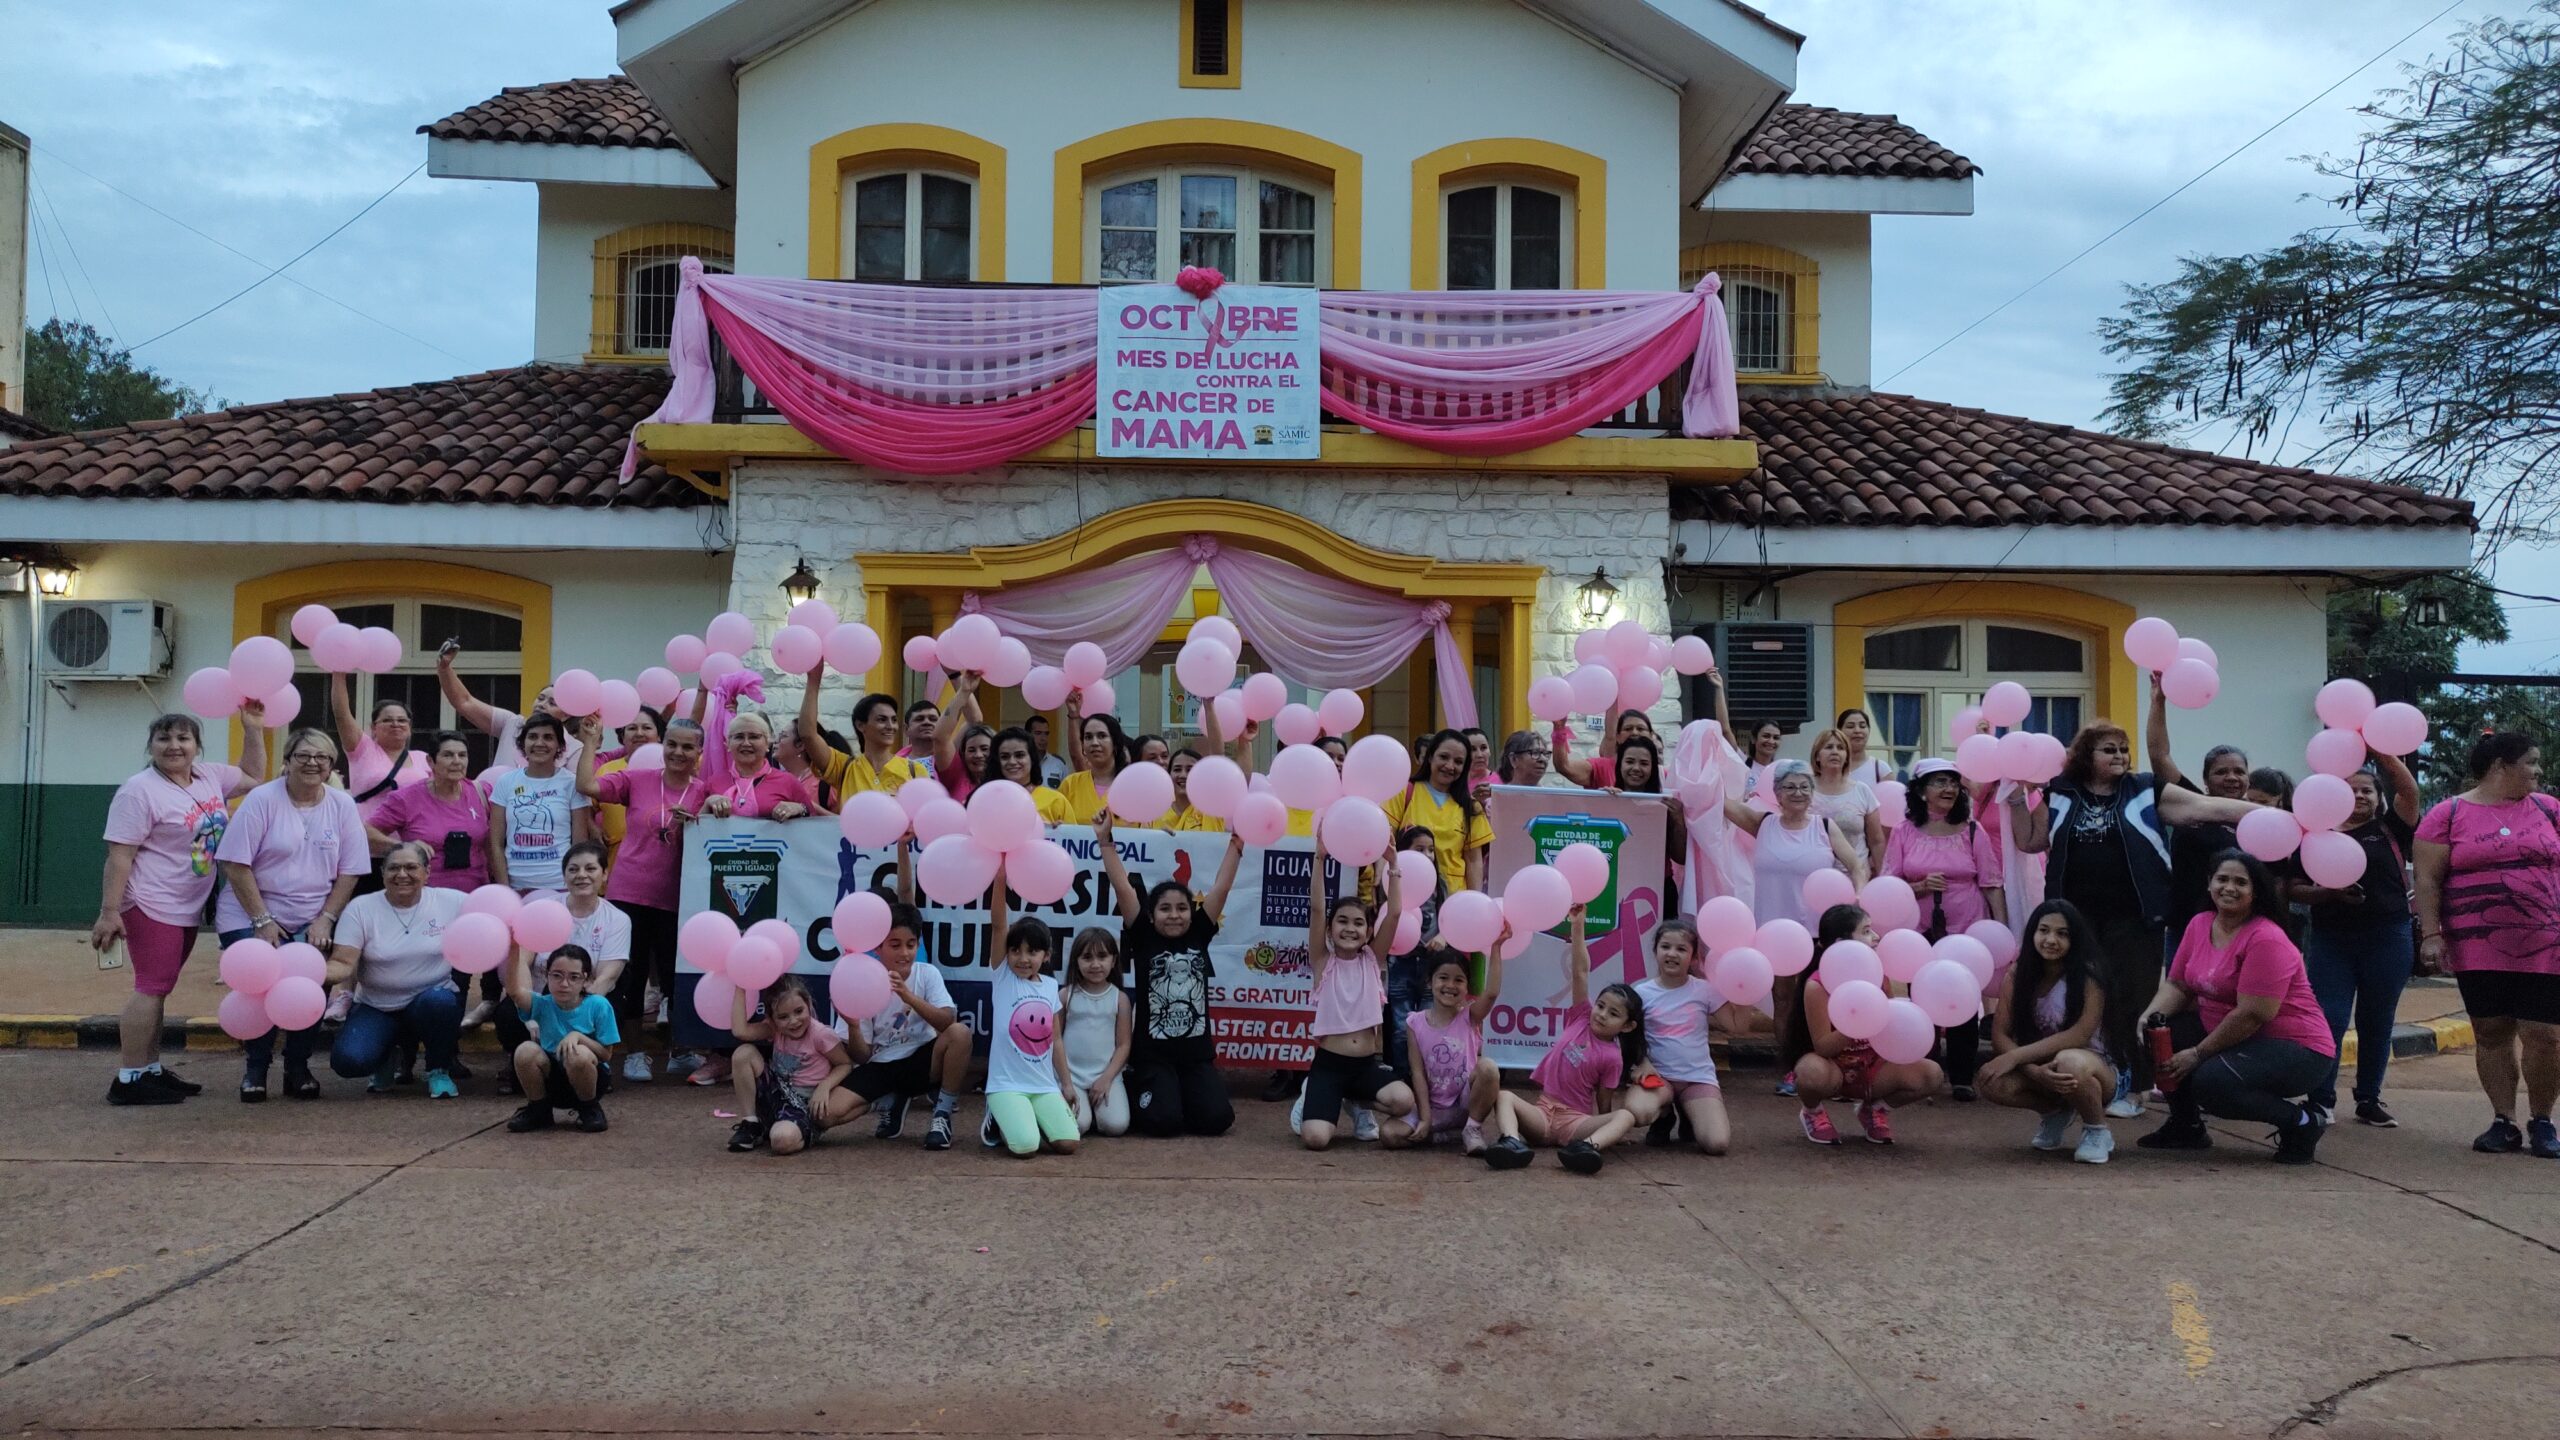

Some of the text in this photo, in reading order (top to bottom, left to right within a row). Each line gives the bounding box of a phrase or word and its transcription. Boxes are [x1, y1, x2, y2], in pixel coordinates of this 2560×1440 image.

[1117, 350, 1299, 370] MES DE LUCHA
[1196, 374, 1300, 388] CONTRA EL
[1112, 389, 1275, 413] CANCER DE
[1111, 417, 1248, 450] MAMA
[1278, 430, 1311, 439] SAMIC
[1554, 830, 1601, 840] CIUDAD DE
[713, 862, 775, 872] PUERTO IGUAZÚ
[1268, 855, 1336, 878] IGUAÚ
[1267, 885, 1334, 896] DIRECCN
[1266, 896, 1311, 906] MUNICIPA
[1266, 905, 1331, 916] DEPORS
[1514, 1039, 1524, 1047] LA
[1525, 1040, 1549, 1048] LUCHA
